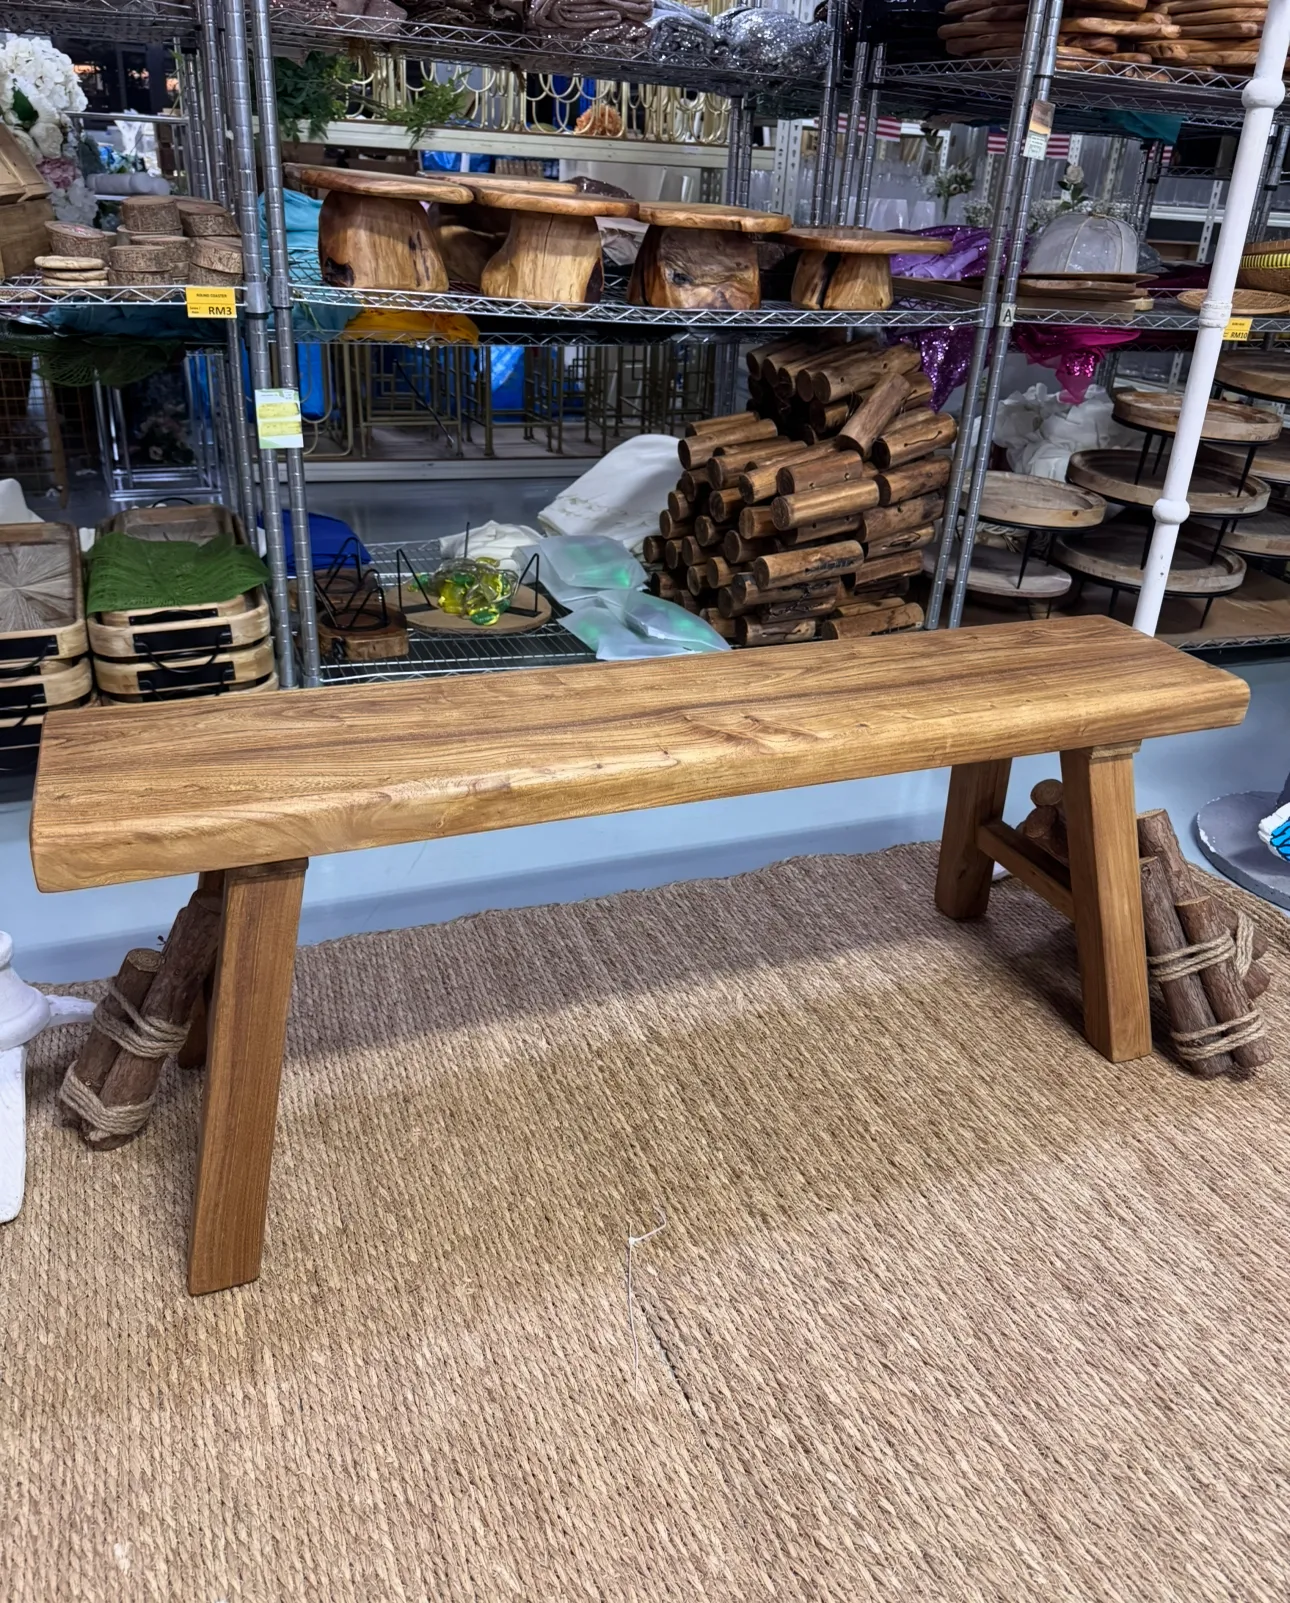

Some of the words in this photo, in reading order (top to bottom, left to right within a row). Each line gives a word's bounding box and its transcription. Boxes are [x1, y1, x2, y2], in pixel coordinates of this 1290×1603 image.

[208, 306, 232, 316] RM3
[1003, 309, 1011, 322] A
[1230, 331, 1248, 339] RM10
